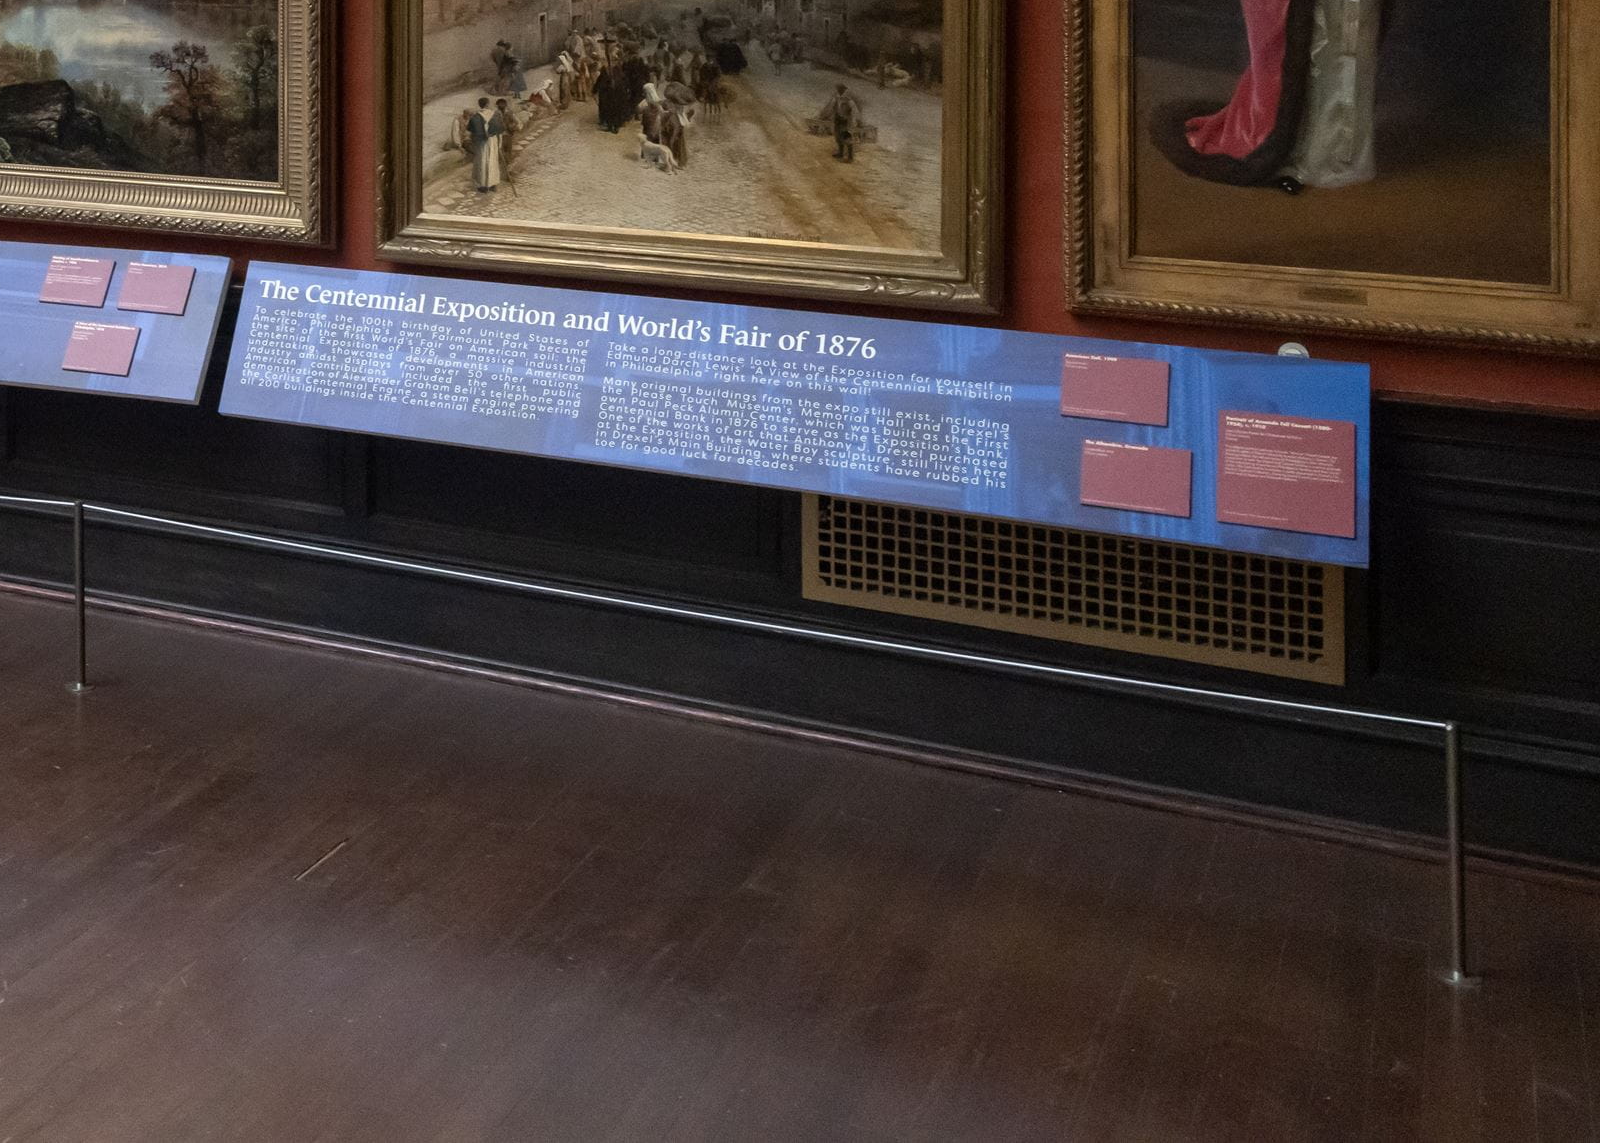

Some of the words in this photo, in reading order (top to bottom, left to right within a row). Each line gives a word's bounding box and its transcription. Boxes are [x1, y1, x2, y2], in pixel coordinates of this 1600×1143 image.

[254, 305, 266, 313] To
[273, 308, 327, 319] celebrate
[334, 313, 353, 322] the
[361, 316, 393, 326] 100th
[401, 320, 451, 334] birthday
[459, 327, 471, 335] of
[479, 328, 519, 340] United
[528, 333, 567, 345] States
[576, 339, 589, 347] of
[260, 280, 299, 301] The
[305, 284, 425, 314] Centennial
[432, 296, 556, 327] Exposition
[563, 312, 609, 331] and
[618, 314, 711, 342] World's
[719, 324, 772, 348] Fair
[778, 330, 810, 352] of
[815, 333, 877, 359] 1876
[249, 328, 310, 341] Centennial
[319, 335, 378, 349] Exposition
[466, 353, 514, 364] massive
[525, 358, 585, 372] industrial
[251, 320, 269, 329] the
[275, 323, 295, 332] site
[301, 326, 313, 334] of
[318, 327, 336, 336] the
[343, 330, 365, 339] first
[419, 338, 442, 348] Fair
[469, 344, 526, 357] American
[565, 354, 586, 364] the
[398, 330, 422, 338] own
[431, 331, 493, 345] Fairmount
[502, 339, 529, 349] Park
[538, 343, 588, 356] became
[243, 360, 324, 376] demonstration
[327, 370, 339, 378] of
[342, 371, 400, 385] Alexander
[404, 379, 449, 391] Graham
[489, 389, 552, 404] telephone
[556, 398, 581, 407] and
[604, 359, 616, 368] in
[713, 372, 746, 382] right
[750, 375, 780, 385] here
[785, 380, 802, 388] on
[807, 381, 832, 391] this
[838, 386, 870, 395] wall!
[606, 342, 636, 352] Take
[654, 347, 744, 364] long-distance
[750, 357, 777, 367] look
[782, 361, 797, 369] at
[802, 362, 824, 372] the
[831, 365, 903, 380] Exposition
[910, 373, 929, 383] for
[935, 378, 993, 390] yourself
[999, 383, 1014, 392] in
[606, 351, 656, 363] Edmund
[662, 357, 699, 368] Darch
[769, 368, 799, 378] View
[805, 372, 818, 380] of
[824, 374, 846, 383] the
[852, 377, 930, 392] Centennial
[937, 386, 1012, 401] Exhibition
[241, 368, 260, 377] the
[262, 370, 301, 382] Corliss
[304, 375, 367, 390] Centennial
[432, 391, 469, 402] steam
[473, 397, 515, 408] engine
[520, 403, 579, 418] powering
[258, 378, 280, 387] 200
[283, 381, 336, 395] buildings
[339, 388, 373, 399] inside
[377, 392, 398, 402] the
[400, 395, 467, 411] Centennial
[598, 403, 669, 418] Centennial
[674, 411, 708, 423] Bank
[710, 416, 723, 424] in
[728, 418, 758, 429] 1876
[763, 422, 777, 431] to
[779, 425, 818, 436] serve
[843, 431, 868, 442] the
[598, 411, 623, 421] One
[628, 415, 640, 423] of
[646, 417, 667, 427] the
[672, 422, 709, 432] works
[715, 426, 727, 434] of
[733, 429, 753, 437] art
[759, 430, 788, 441] that
[794, 435, 851, 451] Anthony
[876, 445, 922, 458] Drexel
[929, 453, 1007, 468] purchased
[594, 437, 615, 447] toe
[620, 441, 637, 450] for
[642, 445, 676, 455] good
[681, 448, 708, 459] luck
[713, 452, 731, 462] for
